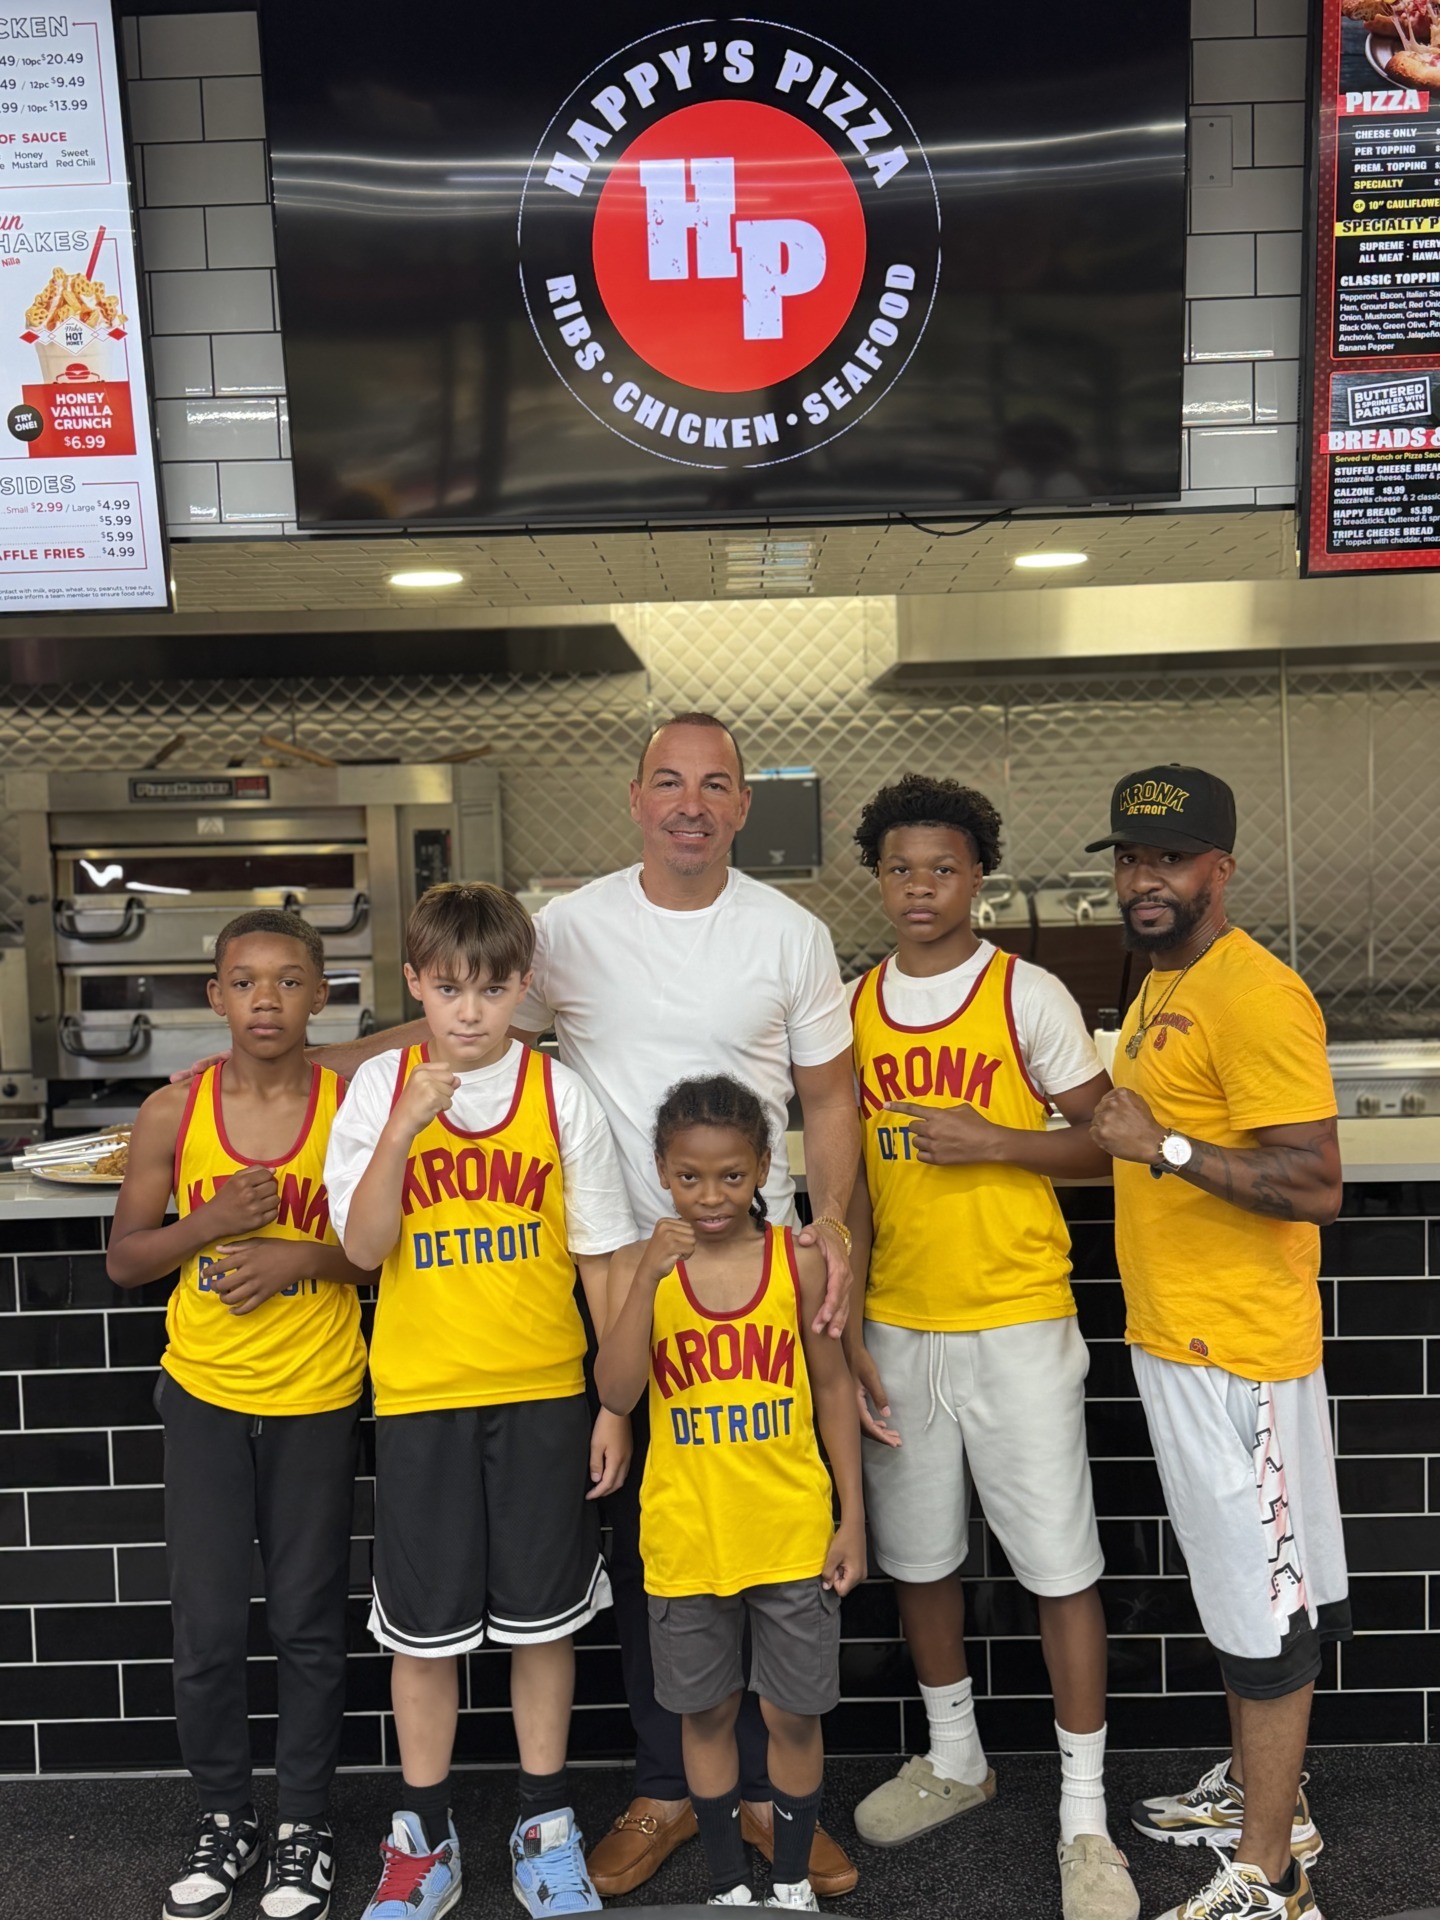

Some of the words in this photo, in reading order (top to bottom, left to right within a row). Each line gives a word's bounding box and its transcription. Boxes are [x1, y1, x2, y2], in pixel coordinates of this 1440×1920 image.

[22, 58, 41, 66] 10pc
[41, 53, 84, 65] $20.49
[30, 81, 50, 90] 12pc
[51, 76, 85, 88] $9.49
[28, 105, 48, 114] 10pc
[49, 100, 88, 111] $13.99
[1346, 90, 1421, 112] PIZZA
[775, 49, 909, 189] PIZZA
[22, 132, 67, 144] SAUCE
[1355, 130, 1390, 139] CHEESE
[1393, 128, 1417, 137] ONLY
[14, 152, 43, 160] Honey
[61, 149, 89, 157] Sweet
[1355, 147, 1373, 156] PER
[1376, 145, 1416, 155] TOPPING
[12, 160, 48, 169] Mustard
[56, 159, 74, 167] Red
[76, 158, 96, 166] Chili
[1354, 163, 1384, 172] PREM.
[1387, 161, 1427, 171] TOPPING
[1354, 179, 1403, 189] SPECIALTY
[1342, 217, 1424, 233] SPECIALTY
[1359, 241, 1404, 251] SUPREME
[1359, 254, 1376, 263] ALL
[1378, 253, 1404, 262] MEAT
[1340, 274, 1392, 286] CLASSIC
[1395, 272, 1440, 284] TOPPIN
[1340, 292, 1379, 302] Pepperoni,
[1406, 290, 1428, 298] Italian
[1389, 301, 1407, 309] Beef,
[1340, 314, 1363, 322] Onion,
[1365, 312, 1404, 320] Mushroom,
[66, 332, 82, 340] HOT
[1339, 333, 1375, 342] Anchovie,
[1368, 343, 1394, 351] Pepper
[546, 274, 606, 372] RIBS
[612, 382, 780, 448] CHICKEN
[802, 263, 916, 426] SEAFOOD
[56, 392, 105, 405] HONEY
[1354, 384, 1424, 402] BUTTERED
[1362, 398, 1403, 408] SPRINKLED
[1405, 394, 1425, 402] WITH
[51, 405, 113, 418] VANILLA
[1355, 400, 1424, 419] PARMESAN
[15, 413, 32, 423] TRY
[54, 418, 112, 430] CRUNCH
[15, 422, 38, 432] ONE!
[64, 435, 106, 450] $6.99
[1328, 427, 1426, 451] BREADS
[1334, 466, 1374, 476] STUFFED
[1377, 464, 1412, 473] CHEESE
[1414, 463, 1440, 472] BREA
[0, 475, 76, 495] SIDES
[1334, 487, 1375, 497] CALZONE
[1382, 486, 1405, 495] $9.99
[6, 505, 29, 514] Small
[31, 502, 63, 513] $2.99
[72, 503, 96, 514] Large
[97, 500, 130, 510] $4.99
[1334, 509, 1364, 518] HAPPY
[1410, 506, 1433, 515] $5.99
[100, 515, 132, 526] $5.99
[1343, 517, 1387, 525] breadsticks,
[101, 531, 134, 542] $5.99
[1333, 530, 1364, 539] TRIPLE
[1366, 528, 1400, 538] CHEESE
[1403, 527, 1433, 536] BREAD
[1346, 539, 1372, 547] topped
[0, 550, 38, 561] FFLE
[44, 548, 85, 559] FRIES
[102, 546, 135, 557] $4.99
[1120, 781, 1190, 812] KRONK
[1127, 804, 1168, 815] DETROIT
[860, 1046, 1003, 1120] KRONK
[401, 1147, 554, 1216] KRONK
[188, 1173, 330, 1240] KNK
[413, 1221, 541, 1269] DETROIT
[652, 1322, 795, 1400] KRONK
[670, 1398, 794, 1445] DETROIT
